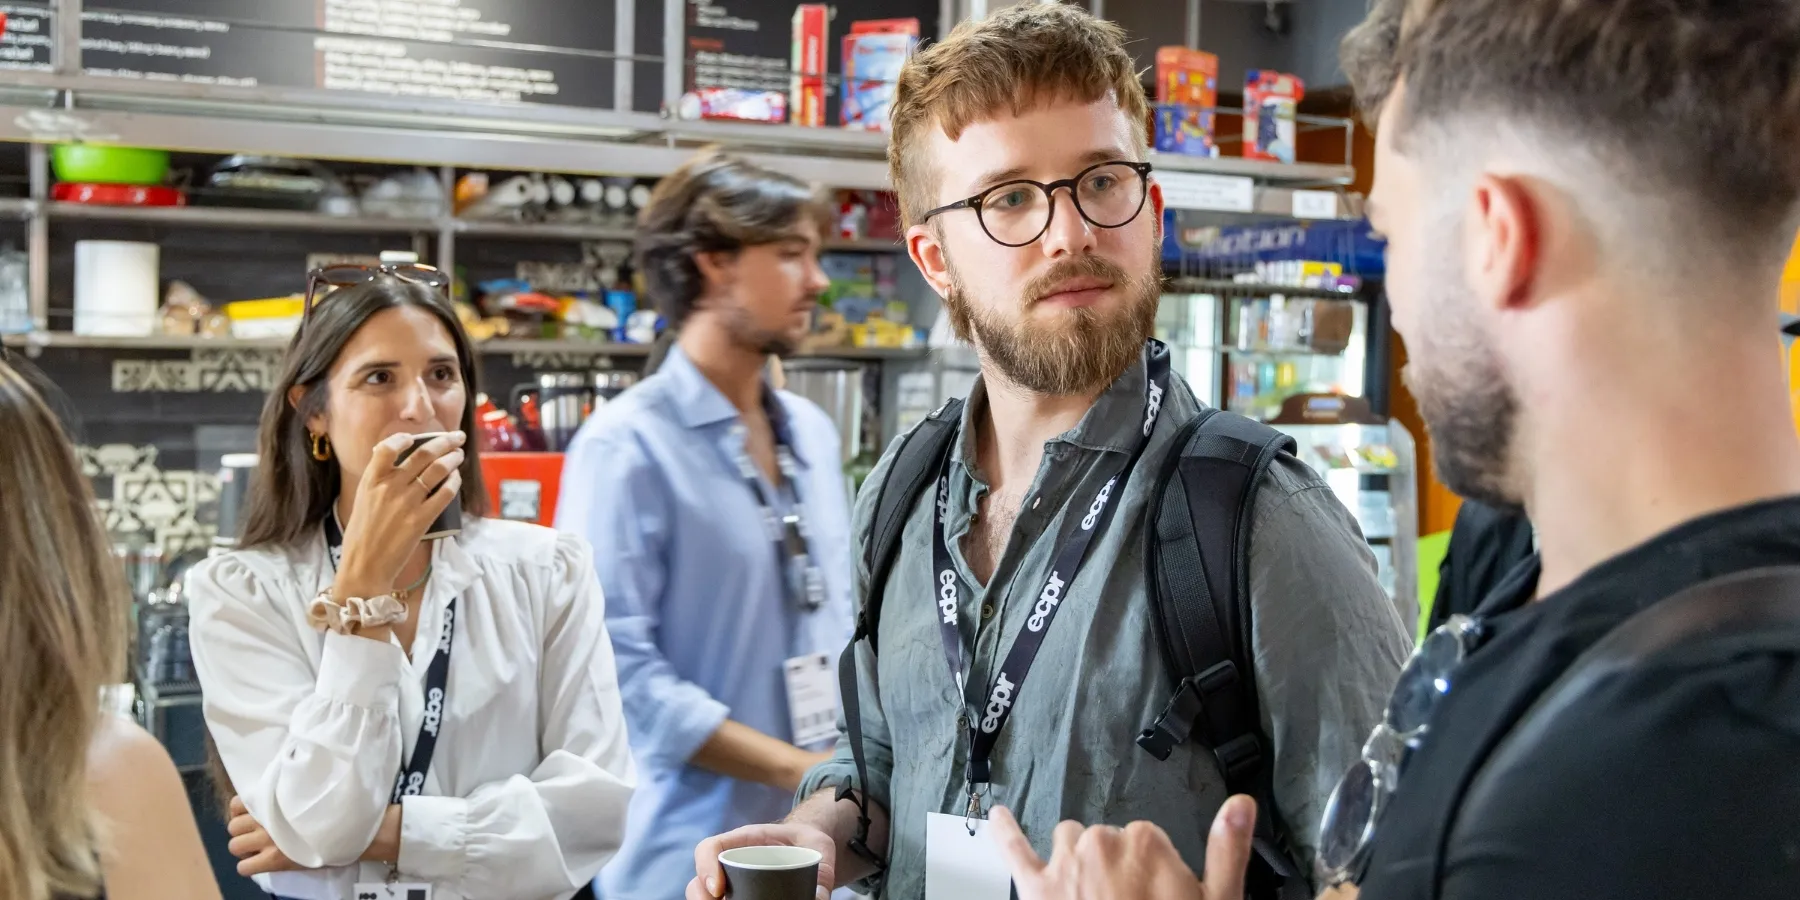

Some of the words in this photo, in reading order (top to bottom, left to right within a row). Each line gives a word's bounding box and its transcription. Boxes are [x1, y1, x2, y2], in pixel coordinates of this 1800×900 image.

[1143, 379, 1163, 437] ecpr
[939, 568, 957, 626] ecpr
[1027, 570, 1065, 633] ecpr
[423, 687, 443, 737] ecpr
[981, 671, 1016, 734] ecpr
[404, 771, 424, 796] ec
